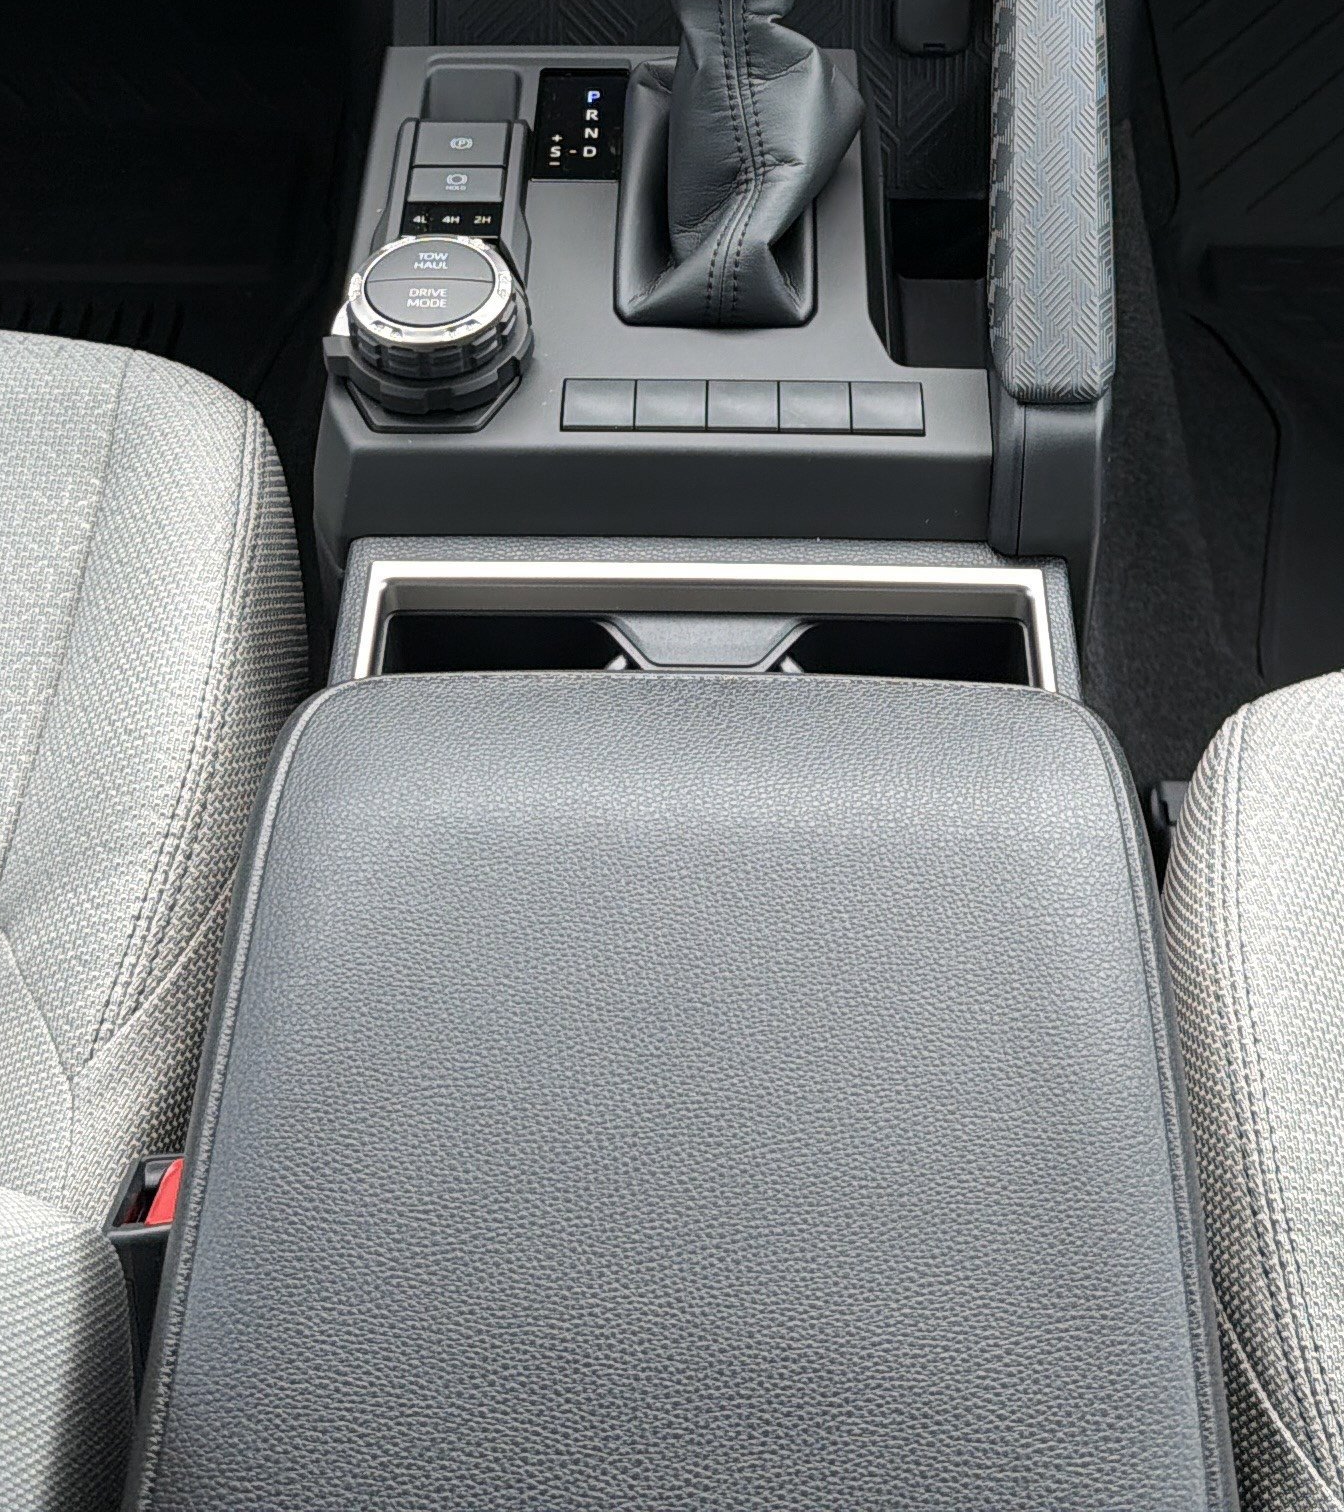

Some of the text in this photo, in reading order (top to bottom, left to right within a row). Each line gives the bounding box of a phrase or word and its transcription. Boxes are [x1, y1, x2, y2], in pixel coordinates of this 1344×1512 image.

[587, 90, 601, 103] P
[585, 109, 599, 121] R
[584, 127, 599, 139] N
[549, 145, 597, 158] S D
[412, 216, 492, 224] 4L 4H 2H
[418, 252, 449, 261] TOW
[413, 261, 449, 269] HAUL
[408, 288, 448, 297] DRIVE
[406, 298, 448, 308] MODE
